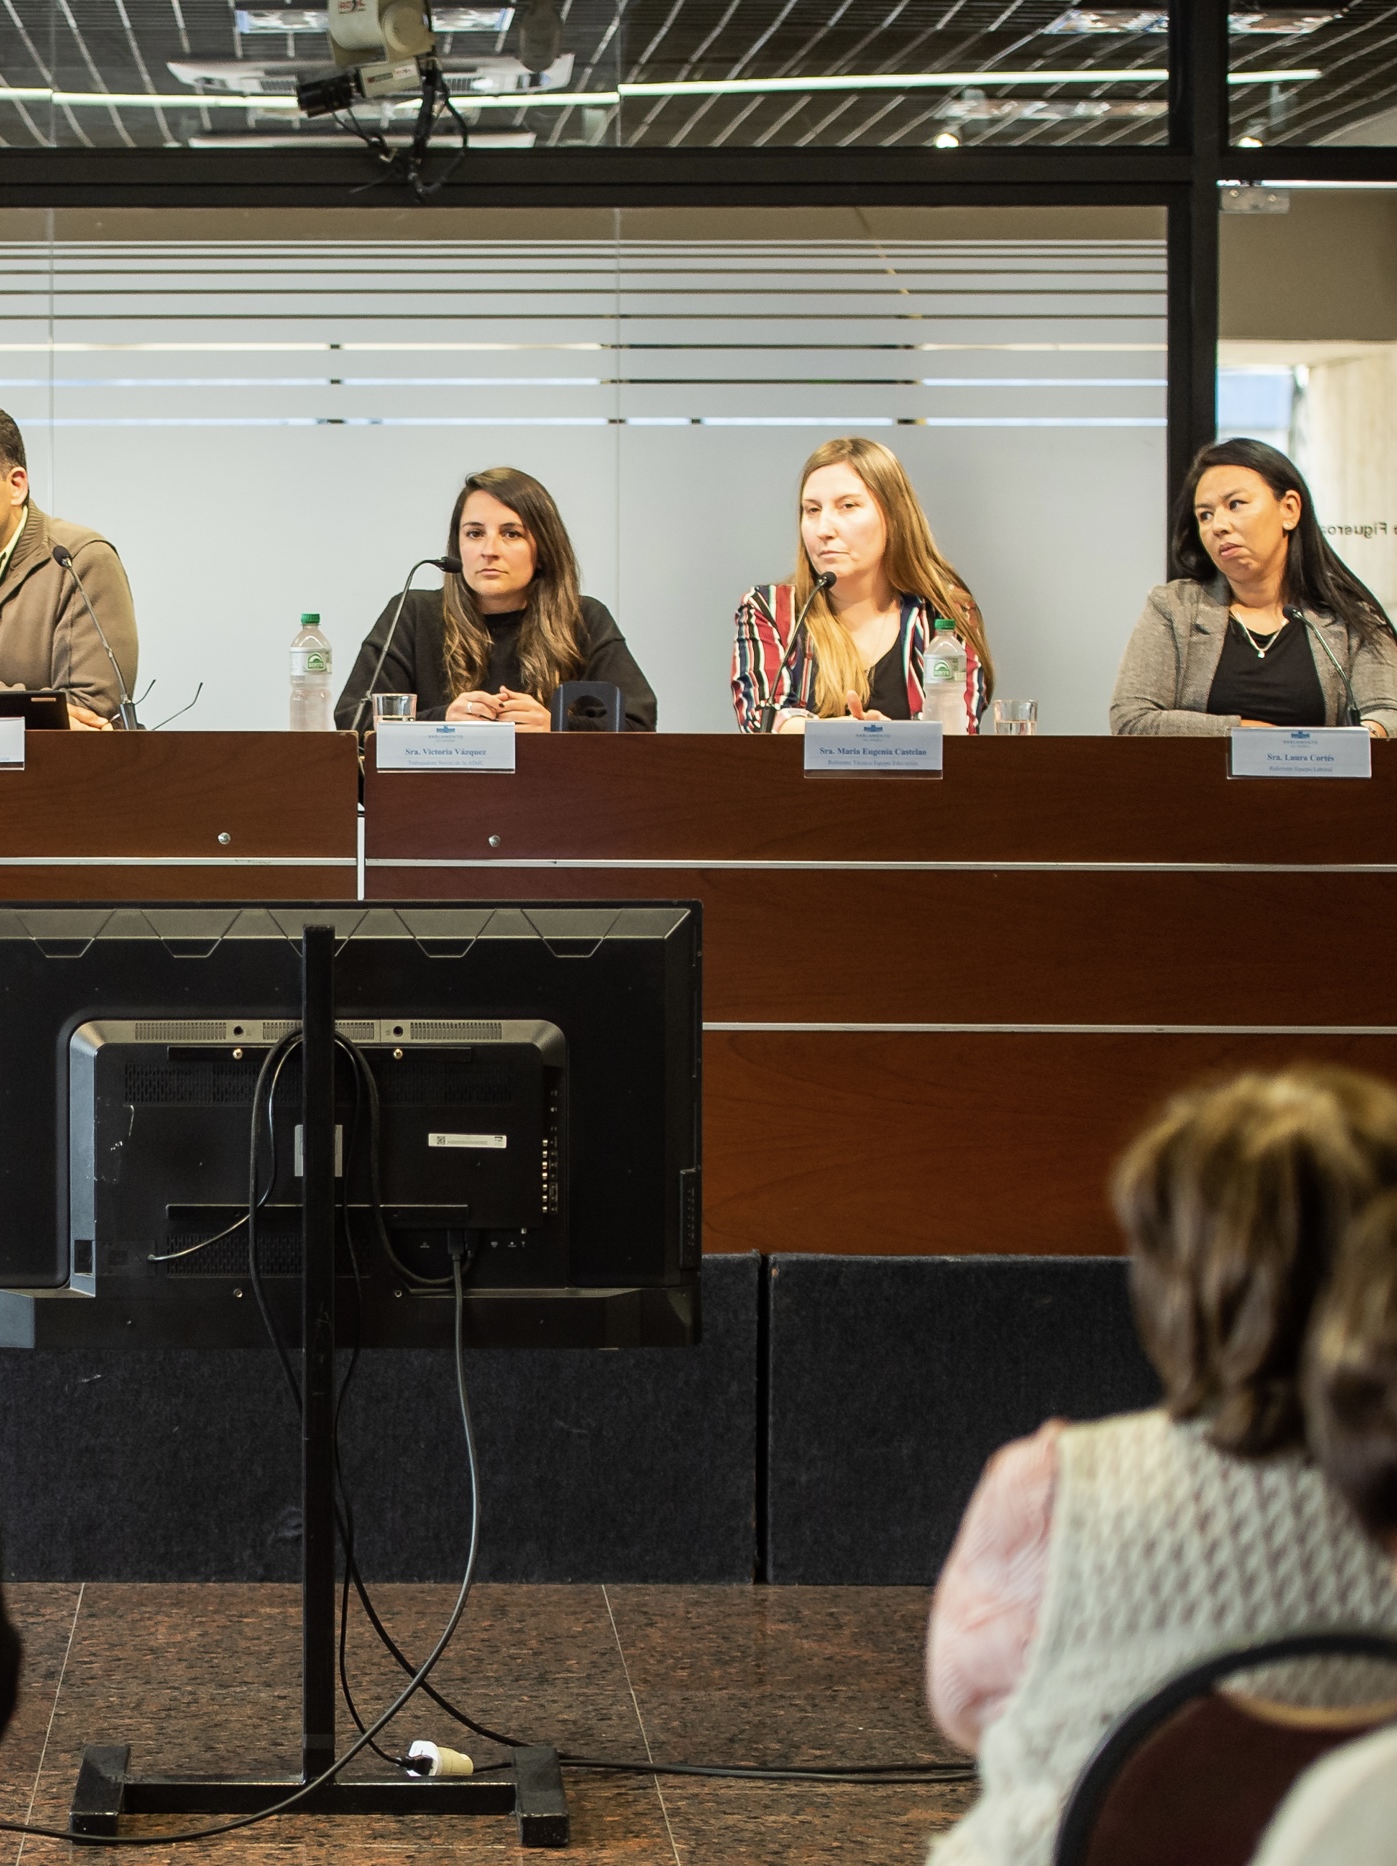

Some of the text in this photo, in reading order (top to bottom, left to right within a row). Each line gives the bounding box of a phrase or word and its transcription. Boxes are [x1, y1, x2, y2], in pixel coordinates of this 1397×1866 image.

[405, 748, 487, 757] Sra. Victoria Vázquez
[819, 747, 835, 755] Sra.
[862, 747, 893, 756] Eugenia
[1267, 753, 1335, 762] Sra. Laura Cortés
